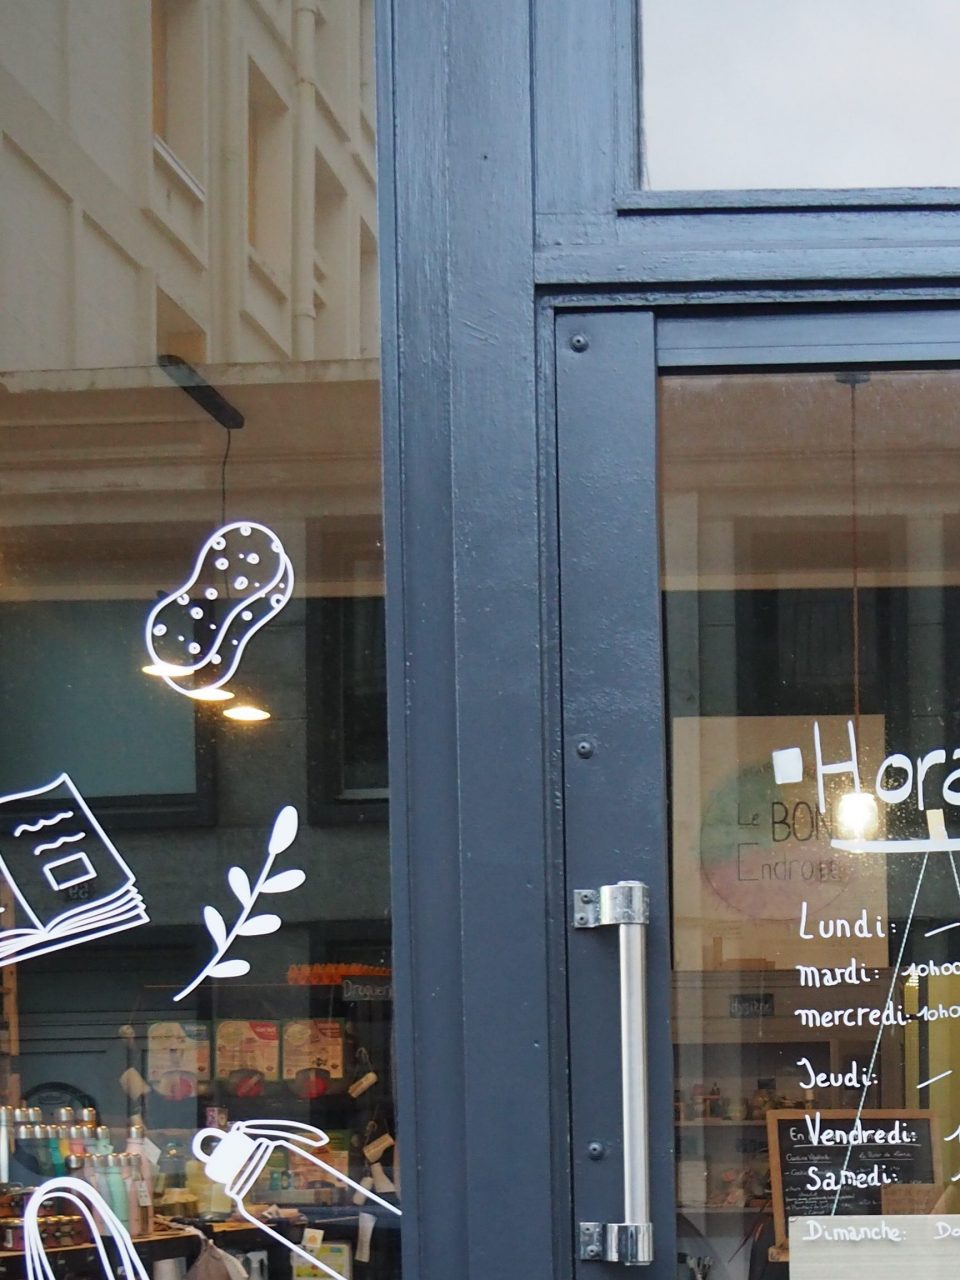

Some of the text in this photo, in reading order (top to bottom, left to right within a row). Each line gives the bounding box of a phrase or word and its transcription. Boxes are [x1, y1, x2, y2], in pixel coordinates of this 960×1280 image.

[737, 802, 761, 827] Le
[799, 901, 897, 940] Lundi:
[795, 957, 880, 989] mardi:
[796, 1056, 879, 1090] Jeudi:
[804, 1111, 918, 1147] Vendredi:
[806, 1163, 899, 1192] Samedi:
[802, 1219, 907, 1242] Dimanche:
